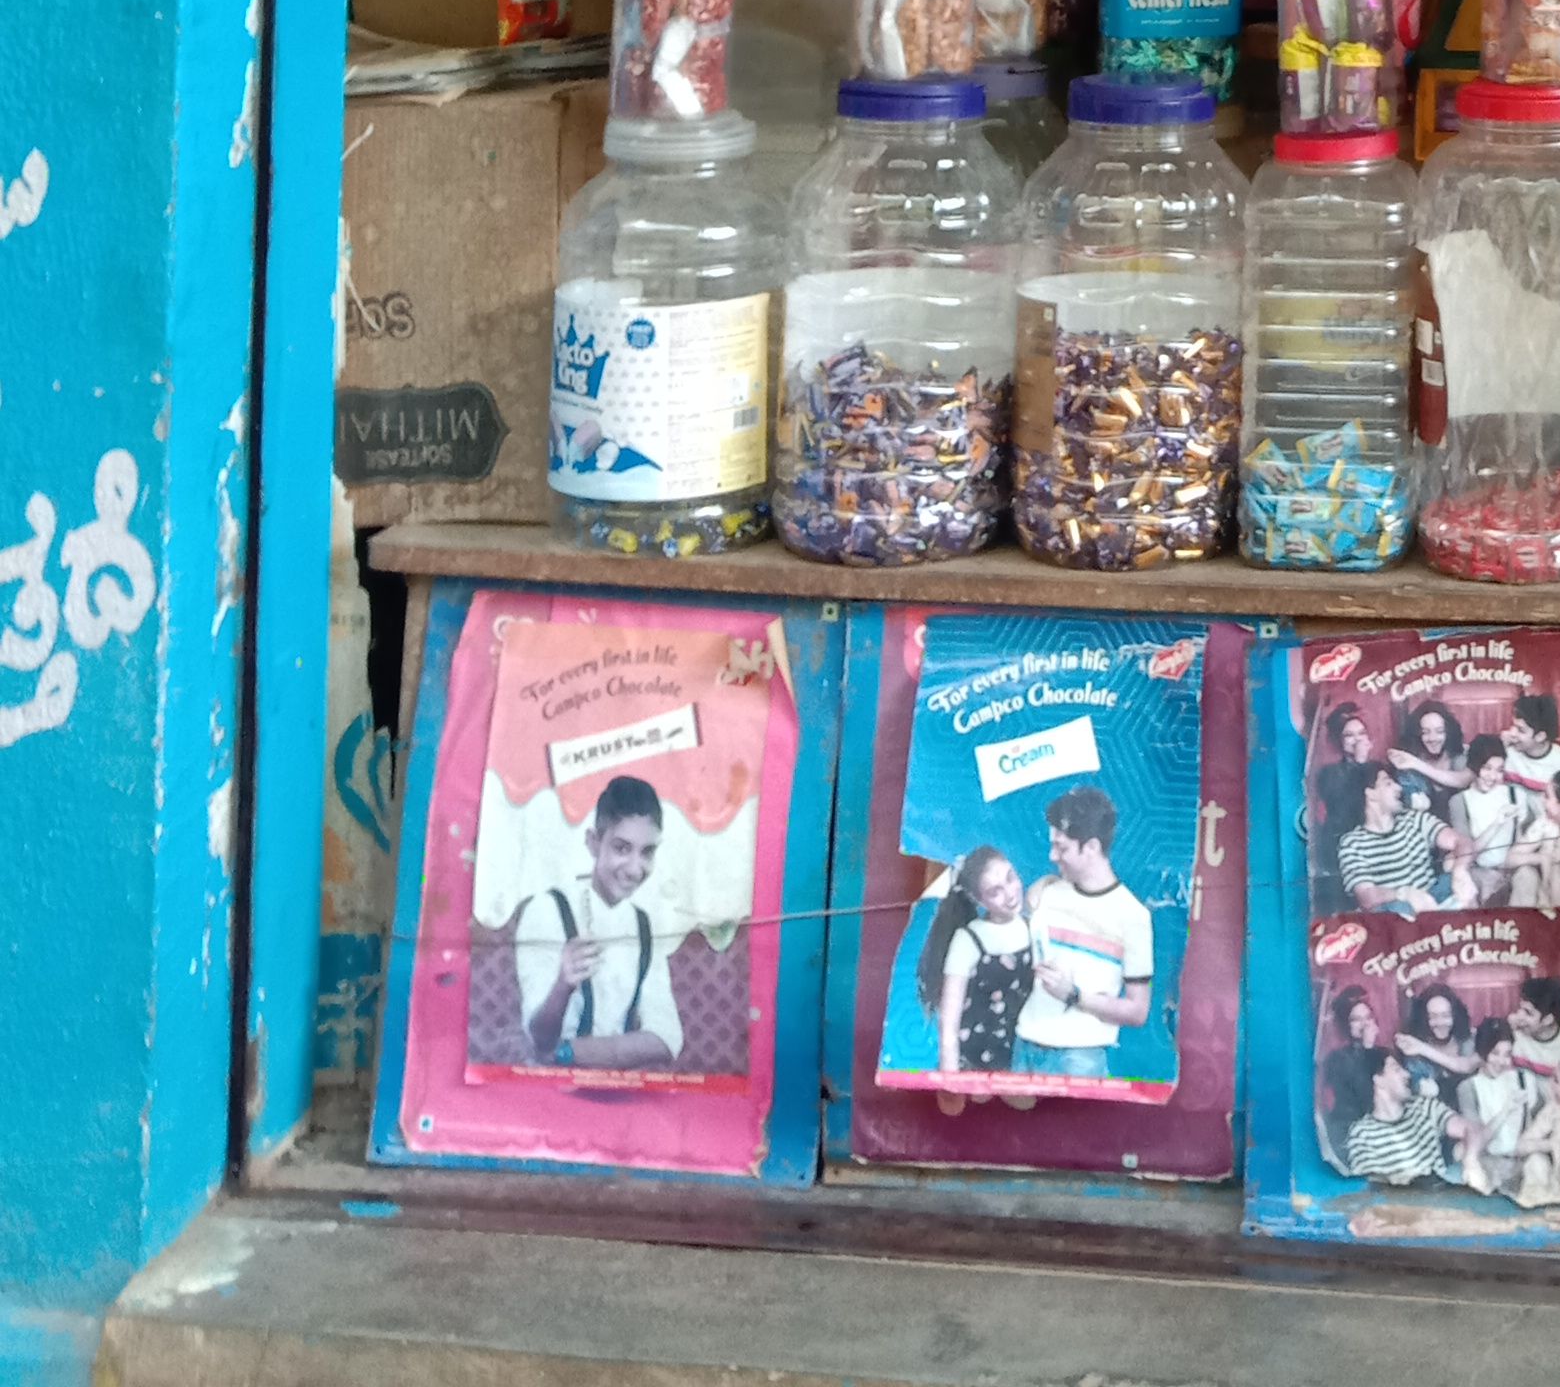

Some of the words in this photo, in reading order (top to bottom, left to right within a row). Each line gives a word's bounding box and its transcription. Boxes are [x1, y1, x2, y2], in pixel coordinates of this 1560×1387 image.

[520, 677, 555, 702] For
[558, 659, 599, 685] every
[602, 646, 632, 668] first
[636, 648, 650, 666] in
[654, 644, 678, 667] life
[927, 682, 969, 713] For
[972, 662, 1021, 694] every
[1022, 651, 1059, 675] first
[1061, 650, 1079, 670] in
[1082, 646, 1111, 672] life
[1357, 669, 1394, 694] For
[1394, 648, 1437, 677] every
[1436, 642, 1469, 663] first
[1470, 641, 1487, 659] in
[1488, 638, 1515, 661] life
[1390, 670, 1452, 702] Campco
[1454, 661, 1534, 688] Chocolate
[541, 686, 602, 721] Campco
[606, 674, 683, 698] Chocolate
[952, 695, 1025, 735] Campco
[1026, 681, 1119, 709] Chocolate
[1362, 952, 1398, 977] For
[1399, 933, 1442, 962] every
[1441, 923, 1473, 946] first
[1475, 921, 1492, 941] in
[1493, 918, 1520, 942] life
[1396, 953, 1459, 985] Campco
[1459, 942, 1540, 969] Chocolate
